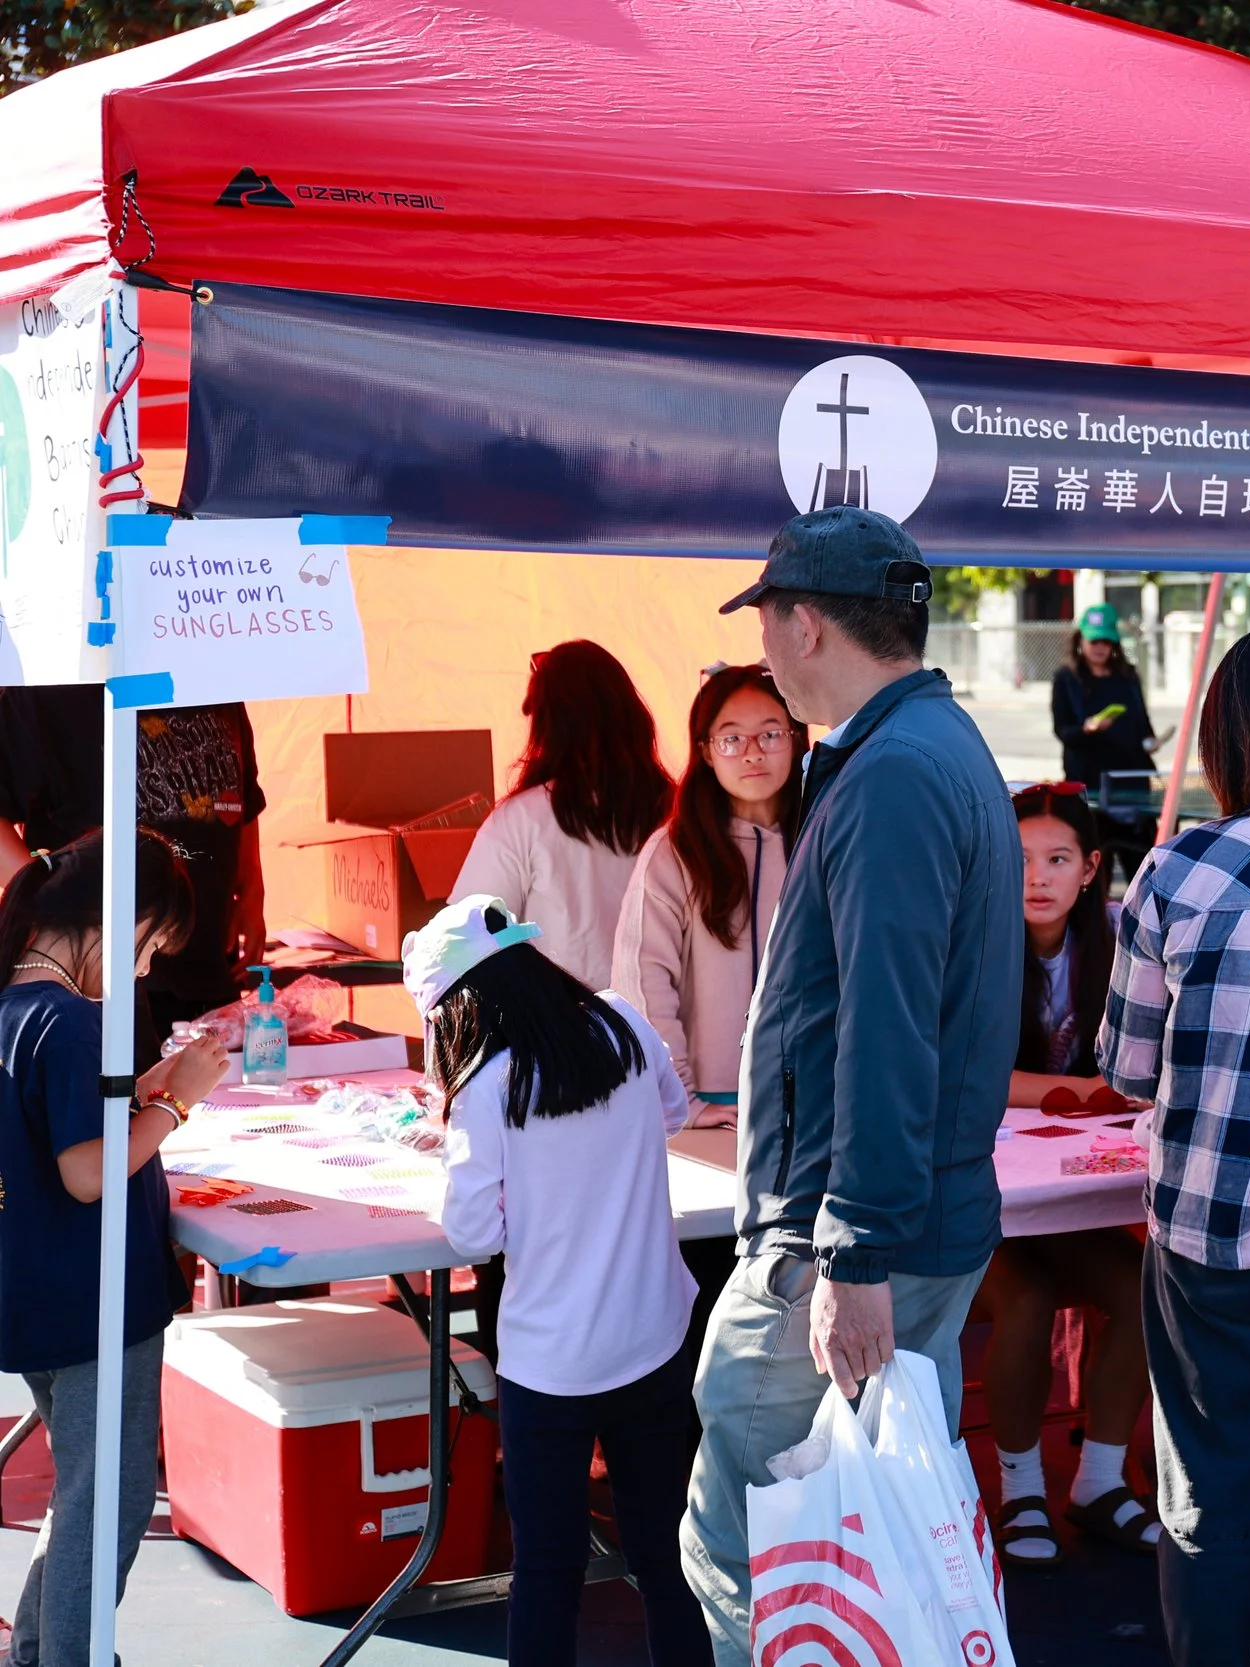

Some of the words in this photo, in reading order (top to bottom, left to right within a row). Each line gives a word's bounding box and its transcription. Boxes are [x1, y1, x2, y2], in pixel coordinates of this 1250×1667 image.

[950, 403, 1068, 440] Chinese
[1077, 411, 1250, 455] Independent
[149, 555, 273, 579] customize
[177, 587, 228, 614] your
[236, 584, 284, 604] own
[153, 608, 334, 640] SUNGLASSES
